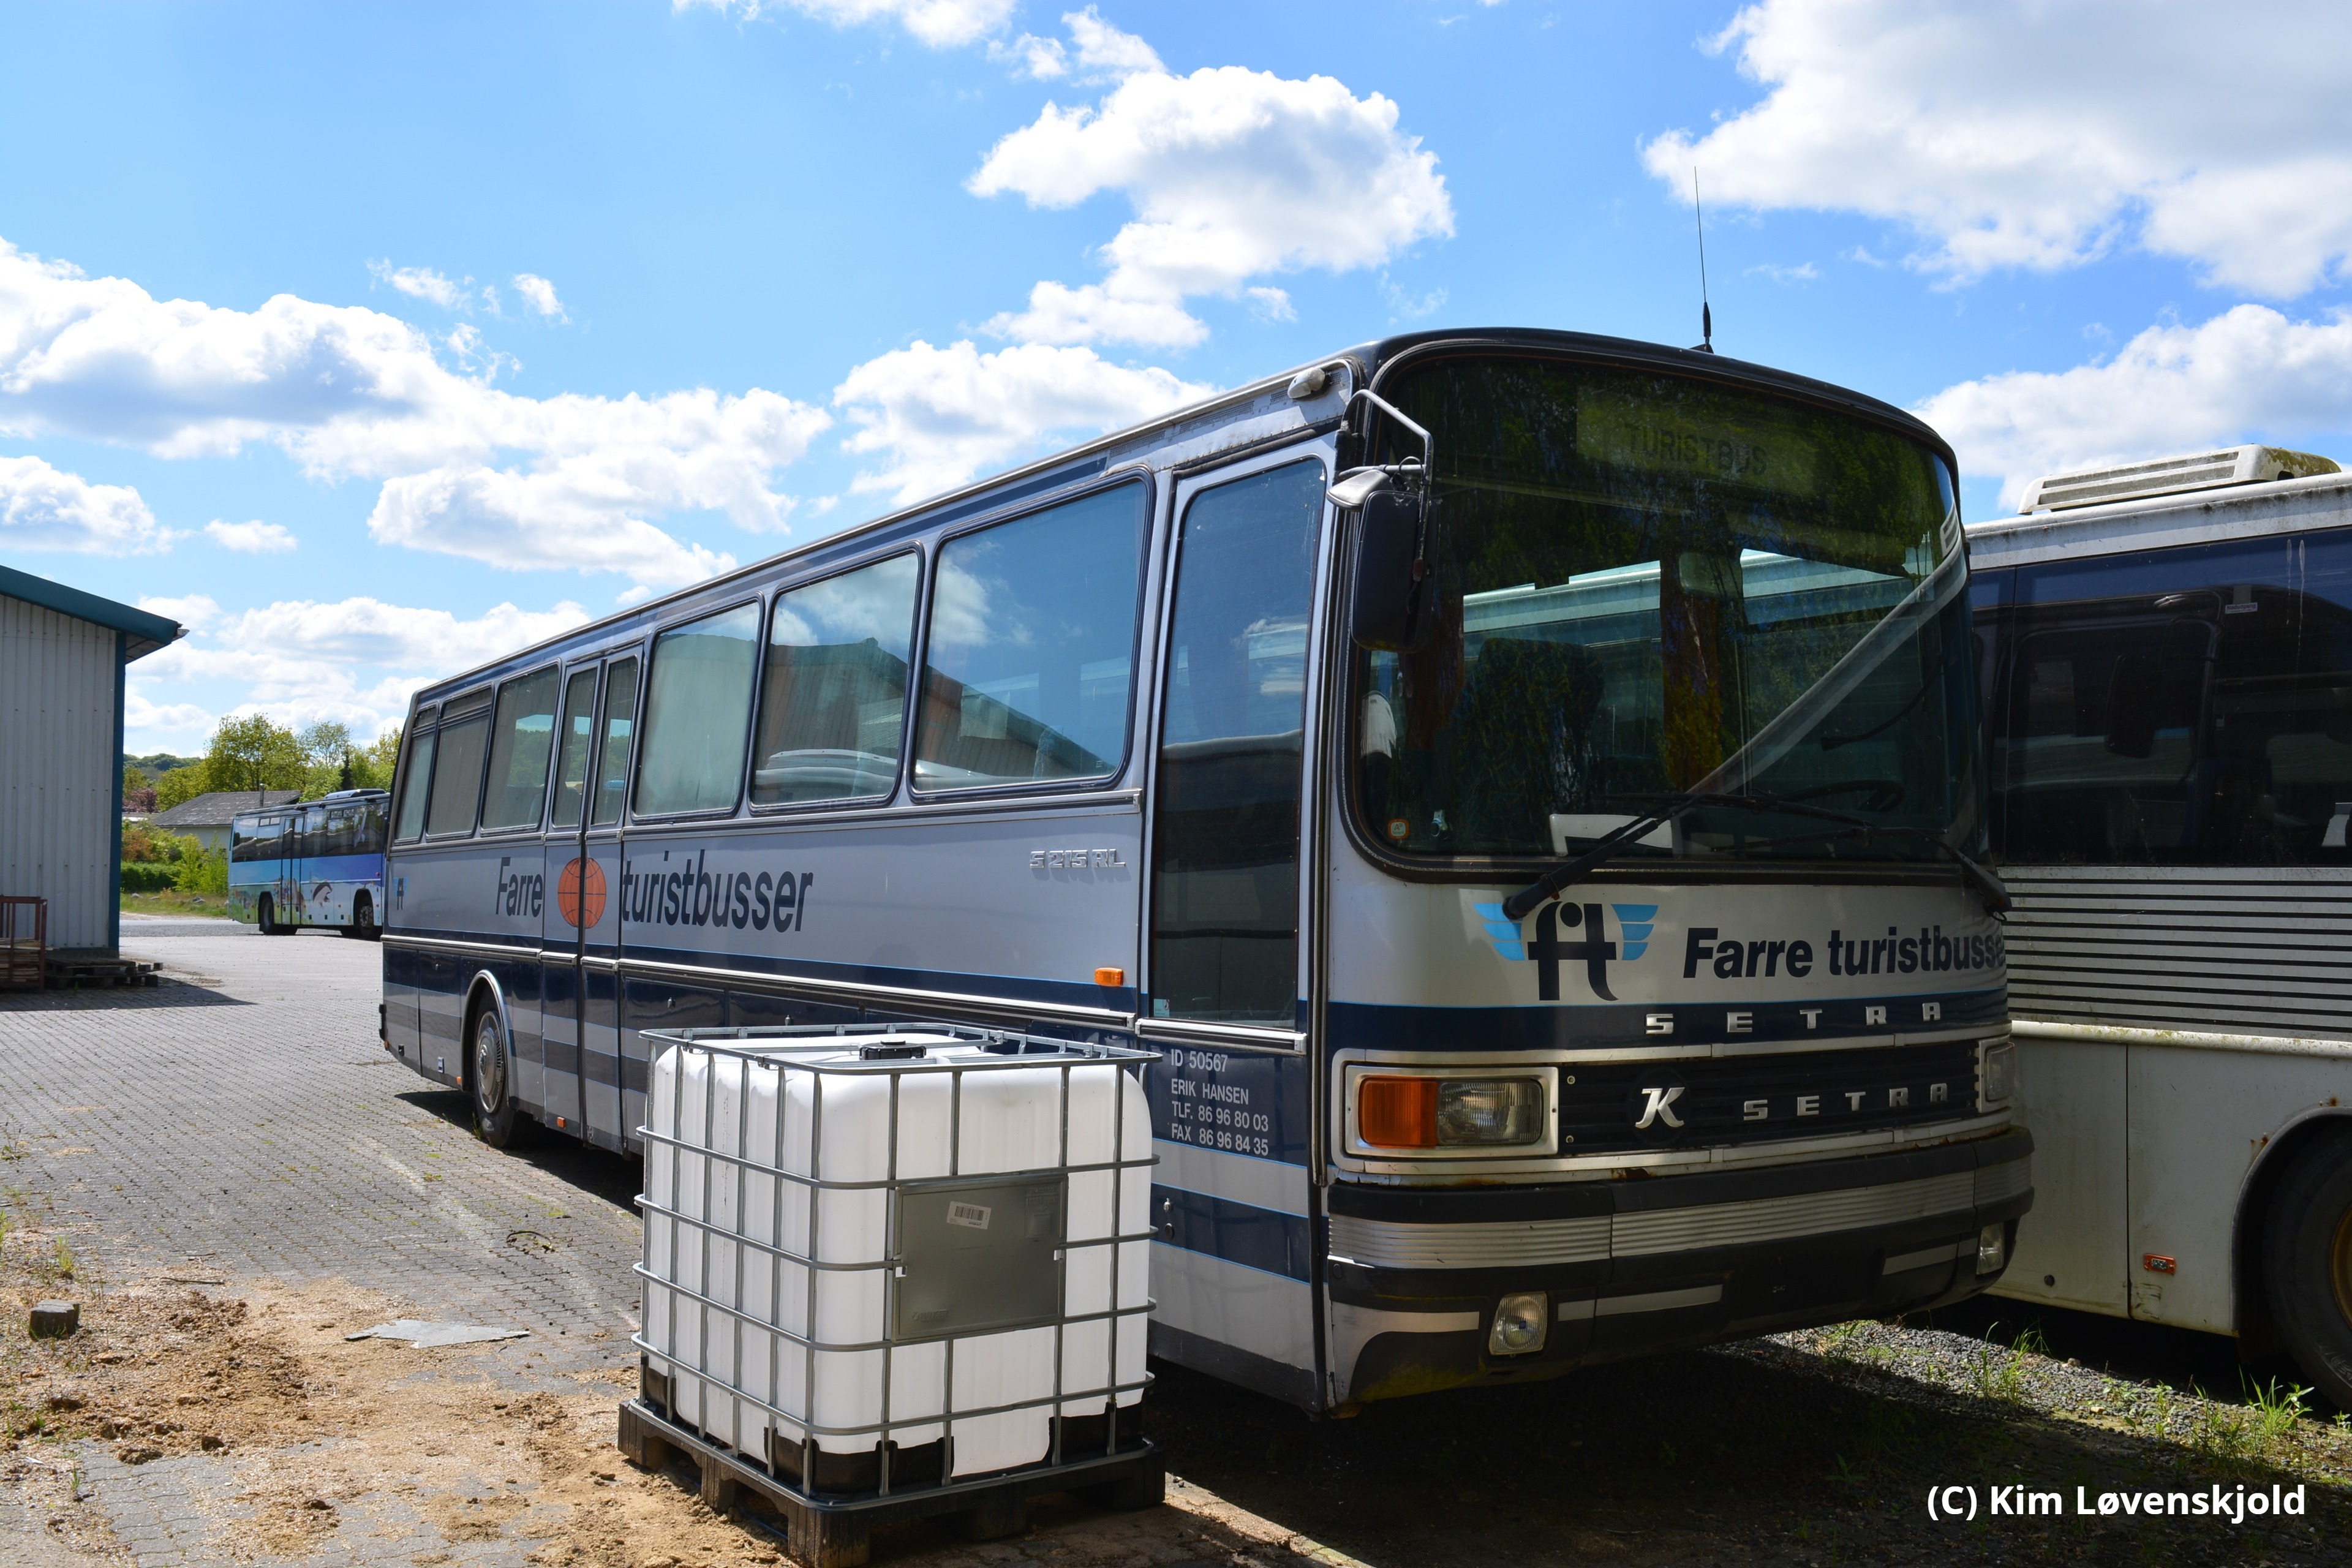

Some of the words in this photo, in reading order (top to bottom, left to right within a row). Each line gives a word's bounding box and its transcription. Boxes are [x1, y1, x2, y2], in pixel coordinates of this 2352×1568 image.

[1624, 423, 1768, 476] TURISTBUS
[495, 857, 543, 918] Farre
[622, 849, 813, 932] turistbusser
[1683, 927, 1813, 978] Farre
[1828, 925, 2007, 976] turistbusse
[1645, 1002, 1941, 1035] SETRA
[1170, 1049, 1183, 1066] ID
[1189, 1052, 1229, 1072] 50567
[1171, 1079, 1196, 1098] ERIK
[1202, 1083, 1249, 1106] HANSEN
[1635, 1087, 1686, 1129] K
[1743, 1082, 1948, 1121] SETRA
[1172, 1101, 1193, 1120] TLF.
[1198, 1104, 1213, 1123] 86
[1216, 1107, 1231, 1126] 96
[1234, 1110, 1250, 1129] 80
[1253, 1114, 1268, 1132] 03
[1172, 1123, 1192, 1142] FAX
[1199, 1127, 1213, 1145] 86
[1216, 1130, 1232, 1149] 96
[1235, 1133, 1250, 1153] 84
[1253, 1137, 1268, 1156] 35
